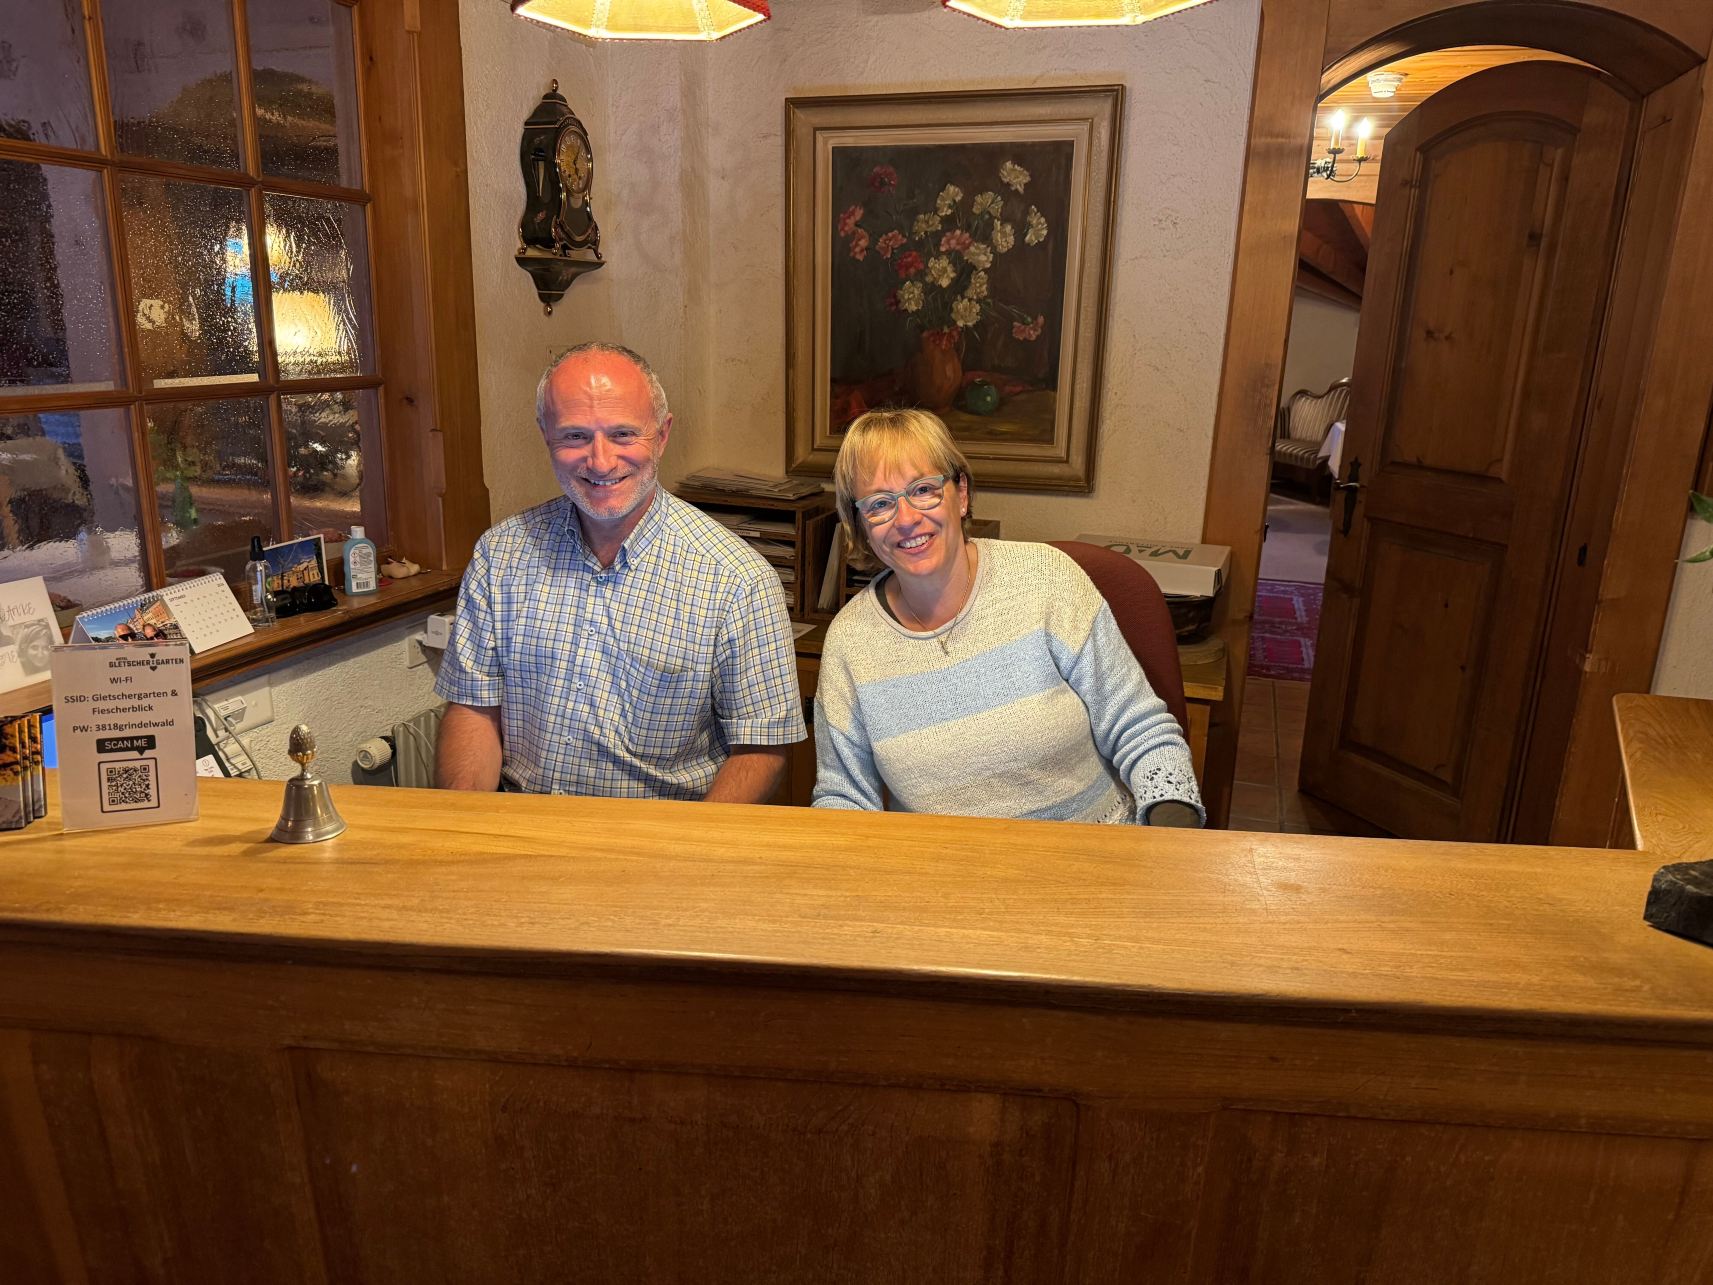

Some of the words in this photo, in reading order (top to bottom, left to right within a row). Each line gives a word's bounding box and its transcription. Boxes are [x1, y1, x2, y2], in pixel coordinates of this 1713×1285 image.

[109, 676, 133, 685] WI-FI
[64, 694, 90, 704] SSID:
[91, 690, 169, 702] Gletschergarten
[170, 689, 179, 697] &
[92, 703, 154, 716] Fiescherblick
[72, 724, 93, 733] PW:
[95, 718, 175, 732] 3818grindelwald
[104, 740, 131, 750] SCAN
[133, 738, 149, 748] ME
